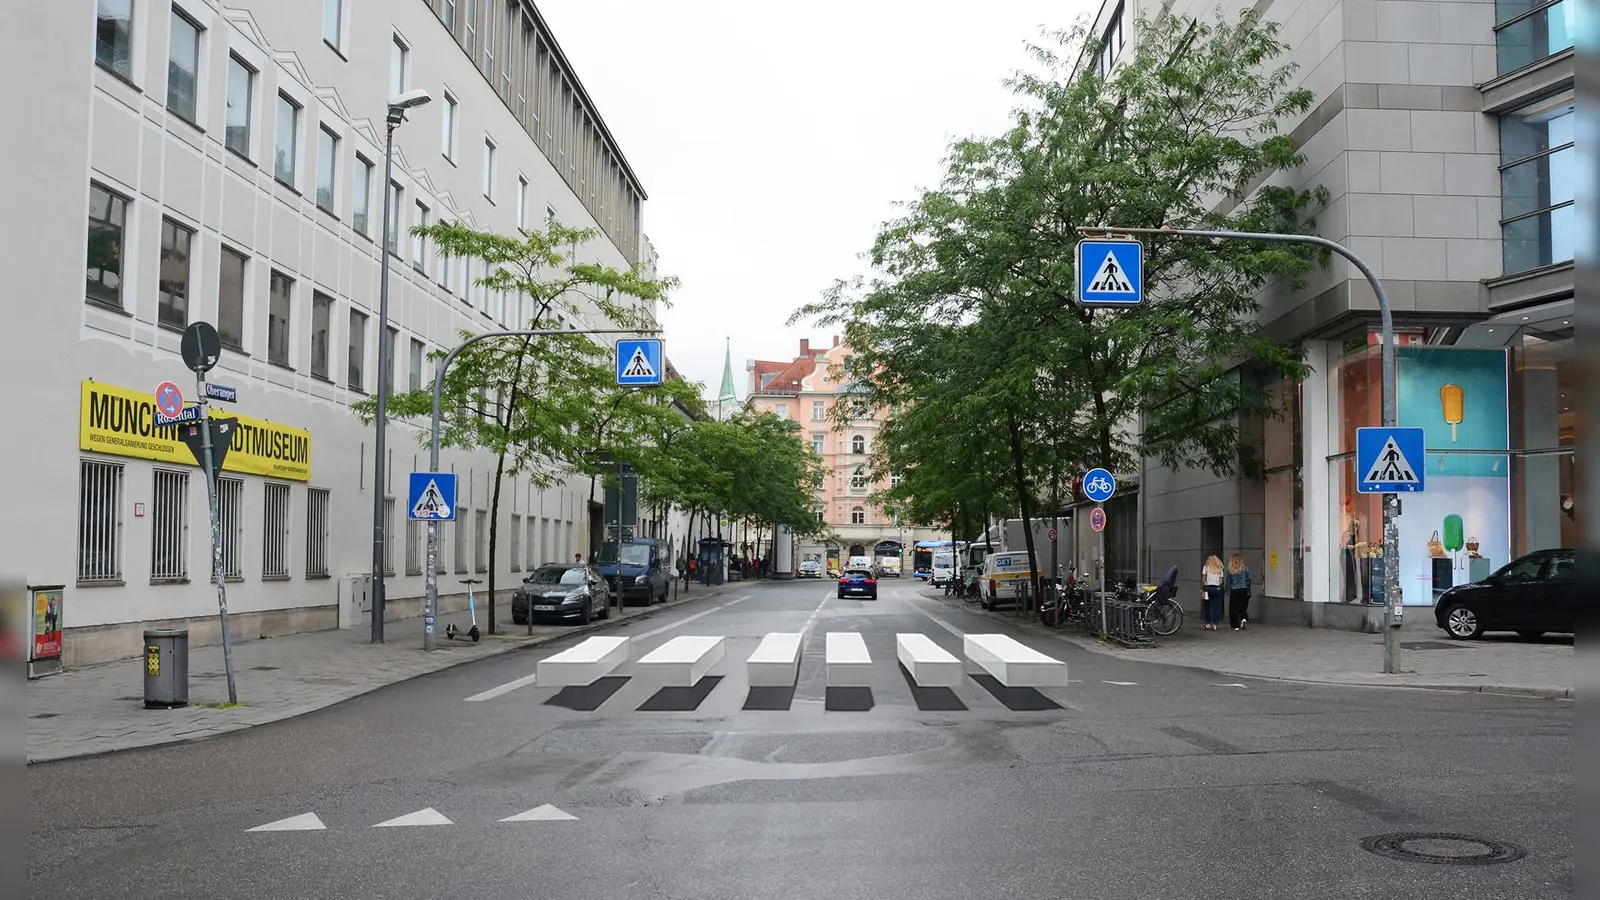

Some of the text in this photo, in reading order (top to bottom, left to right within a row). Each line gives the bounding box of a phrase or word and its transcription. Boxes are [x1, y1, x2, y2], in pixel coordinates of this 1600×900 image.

[206, 384, 235, 401] Oberanger
[89, 434, 175, 453] WEGEN GENERALSANIERUNG GESCHLOSSEN
[996, 558, 1011, 566] GET
